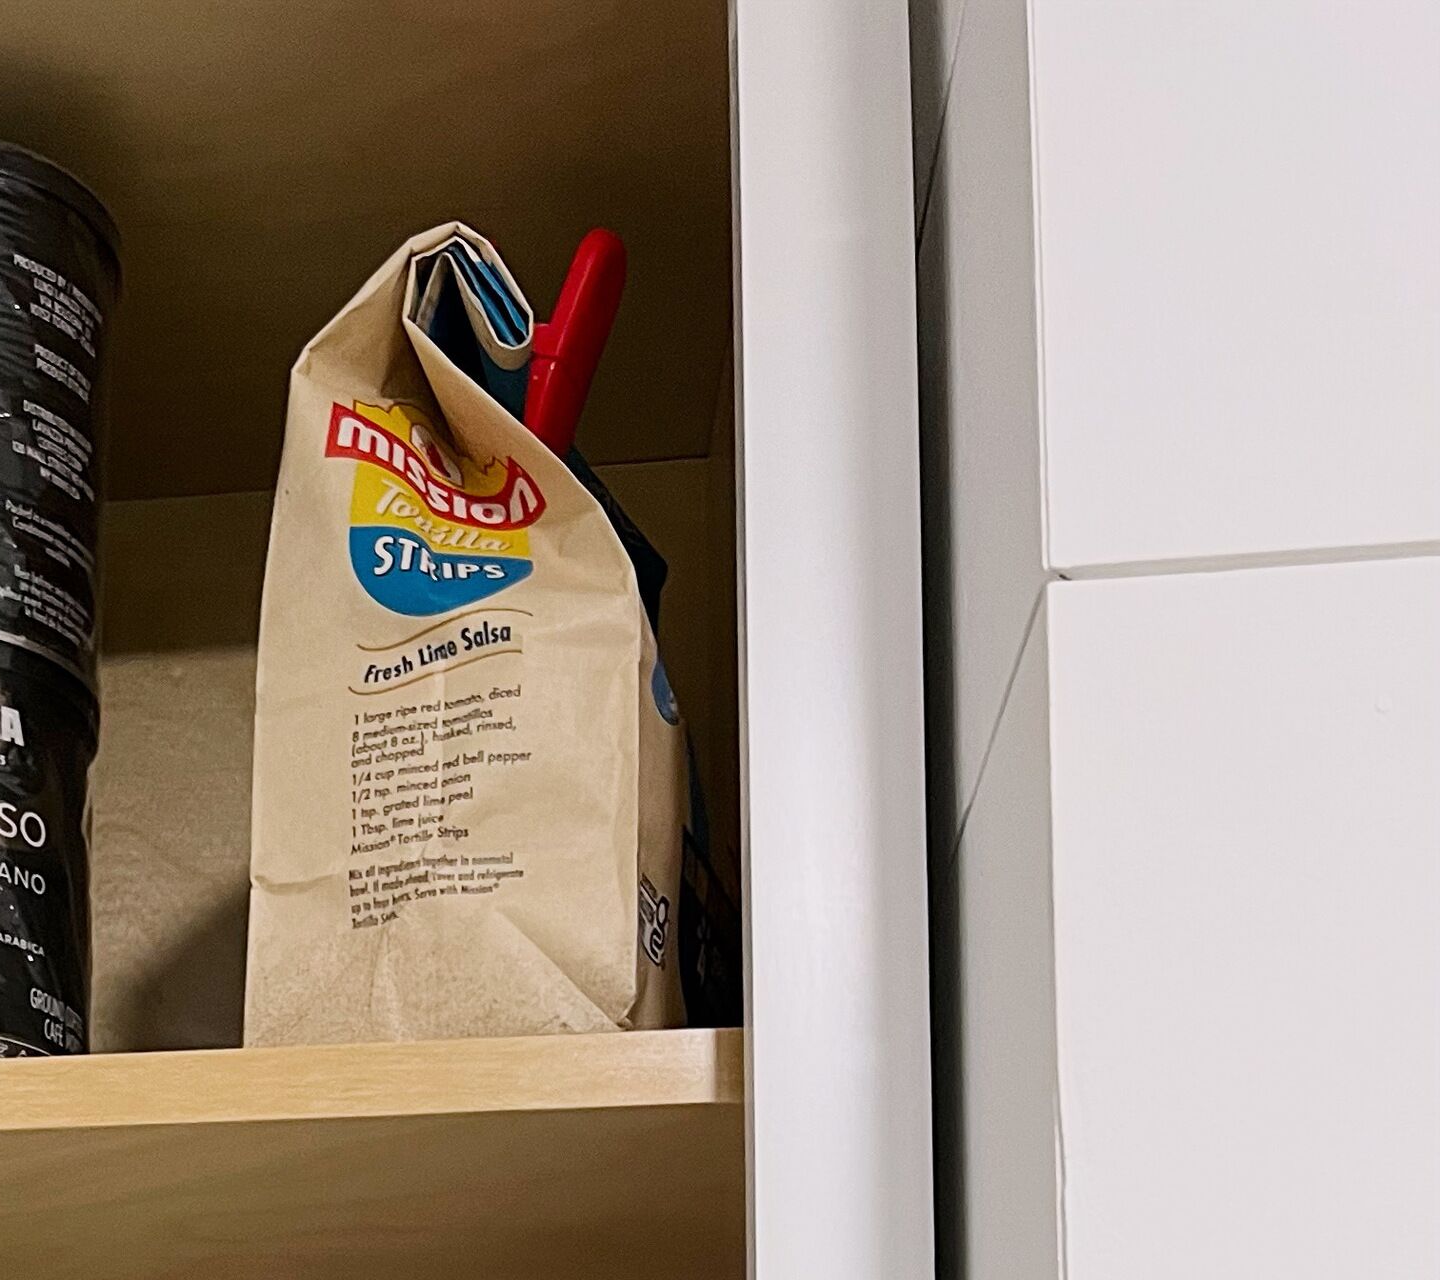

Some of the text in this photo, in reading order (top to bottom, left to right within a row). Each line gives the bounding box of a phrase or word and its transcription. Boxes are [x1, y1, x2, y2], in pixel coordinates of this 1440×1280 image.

[336, 416, 539, 525] MISSION
[375, 478, 512, 551] Tortilla
[373, 535, 506, 581] STRIPS
[363, 621, 512, 684] Fresh Lime Salsa
[354, 714, 359, 726] 1
[363, 711, 392, 725] large
[395, 705, 417, 719] ripe
[421, 699, 441, 713] red
[488, 684, 522, 701] diced
[352, 731, 359, 743] 8
[351, 748, 425, 769] and chopped
[352, 751, 532, 786] 1/4 cup minced red bell pepper
[352, 789, 371, 804] 1/2
[397, 777, 438, 793] minced
[441, 773, 471, 788] onion
[352, 808, 357, 820] 1
[383, 795, 419, 816] grated
[423, 793, 445, 807] lime
[448, 787, 474, 805] peel
[352, 826, 357, 838] 1
[392, 817, 414, 829] lime
[418, 813, 444, 828] juice
[398, 830, 433, 844] Tortilla
[437, 826, 469, 840] Strips
[414, 887, 437, 900] Serve
